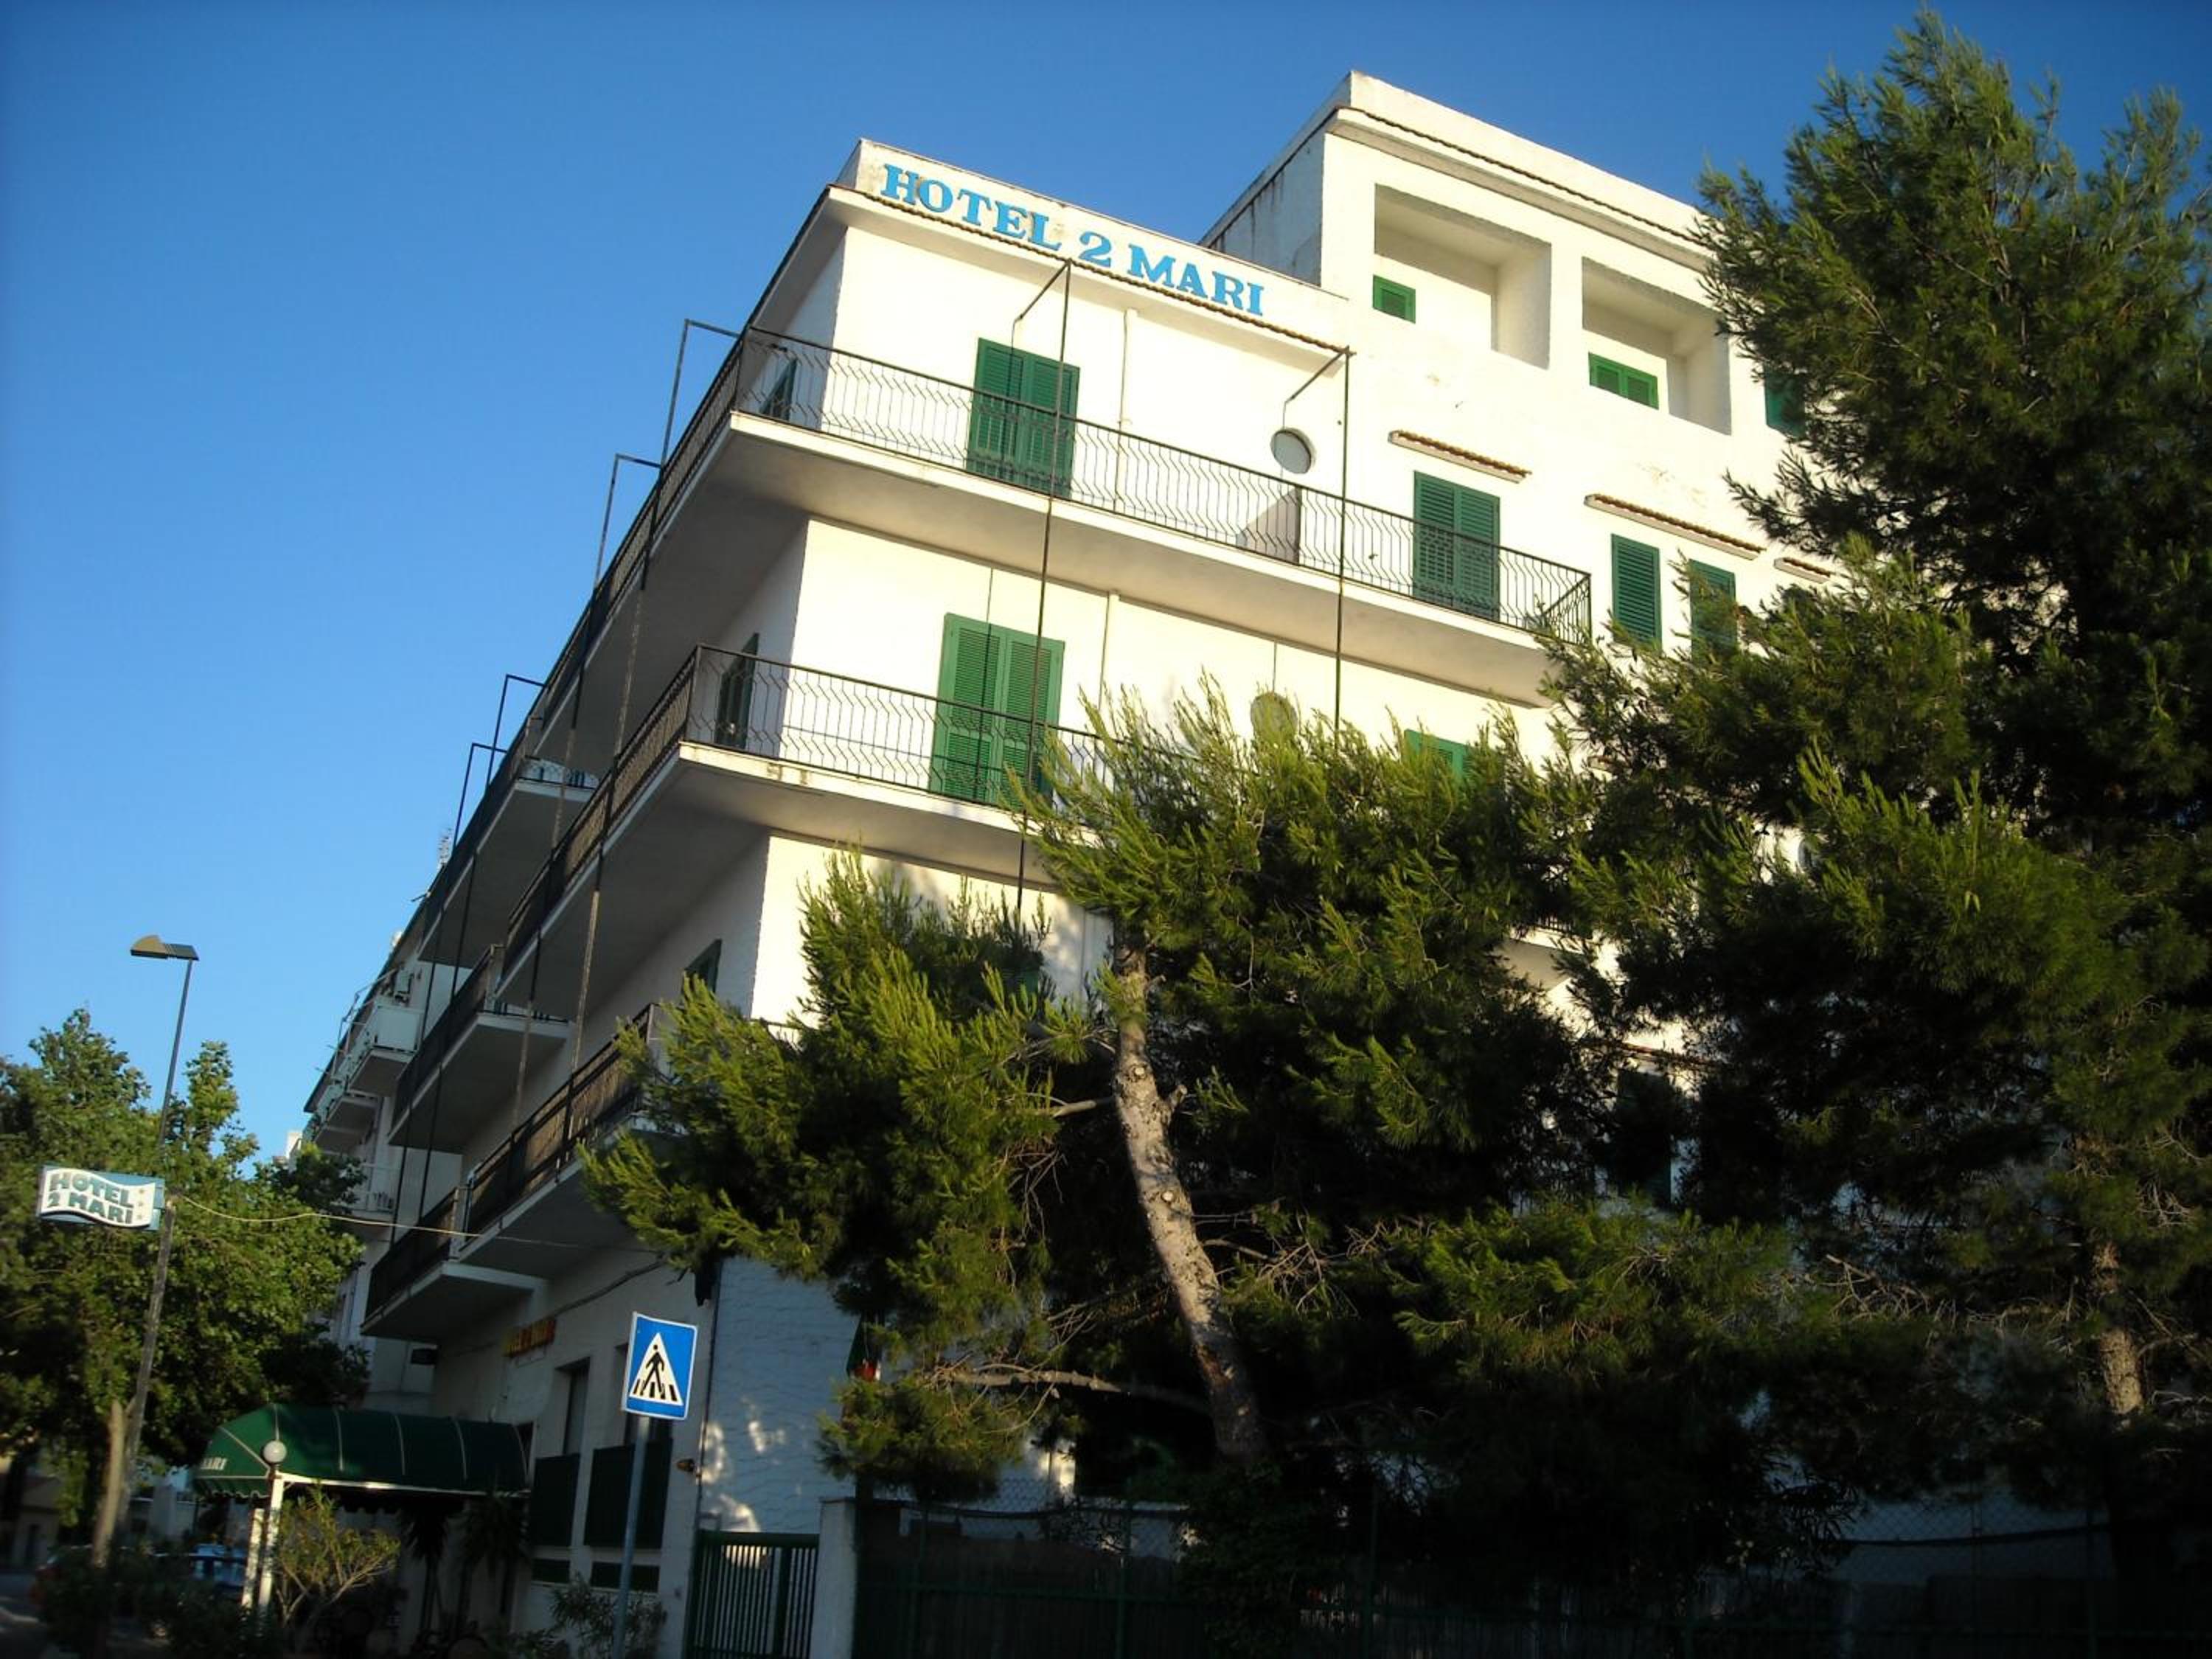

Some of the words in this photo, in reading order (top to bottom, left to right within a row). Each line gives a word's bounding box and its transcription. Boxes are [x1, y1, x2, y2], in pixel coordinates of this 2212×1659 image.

[881, 164, 1061, 251] HOTEL
[1079, 231, 1111, 268] 2
[1127, 243, 1264, 316] MARI
[47, 1192, 60, 1207] 2
[69, 1192, 133, 1224] MARI
[48, 1172, 133, 1208] HOTEL
